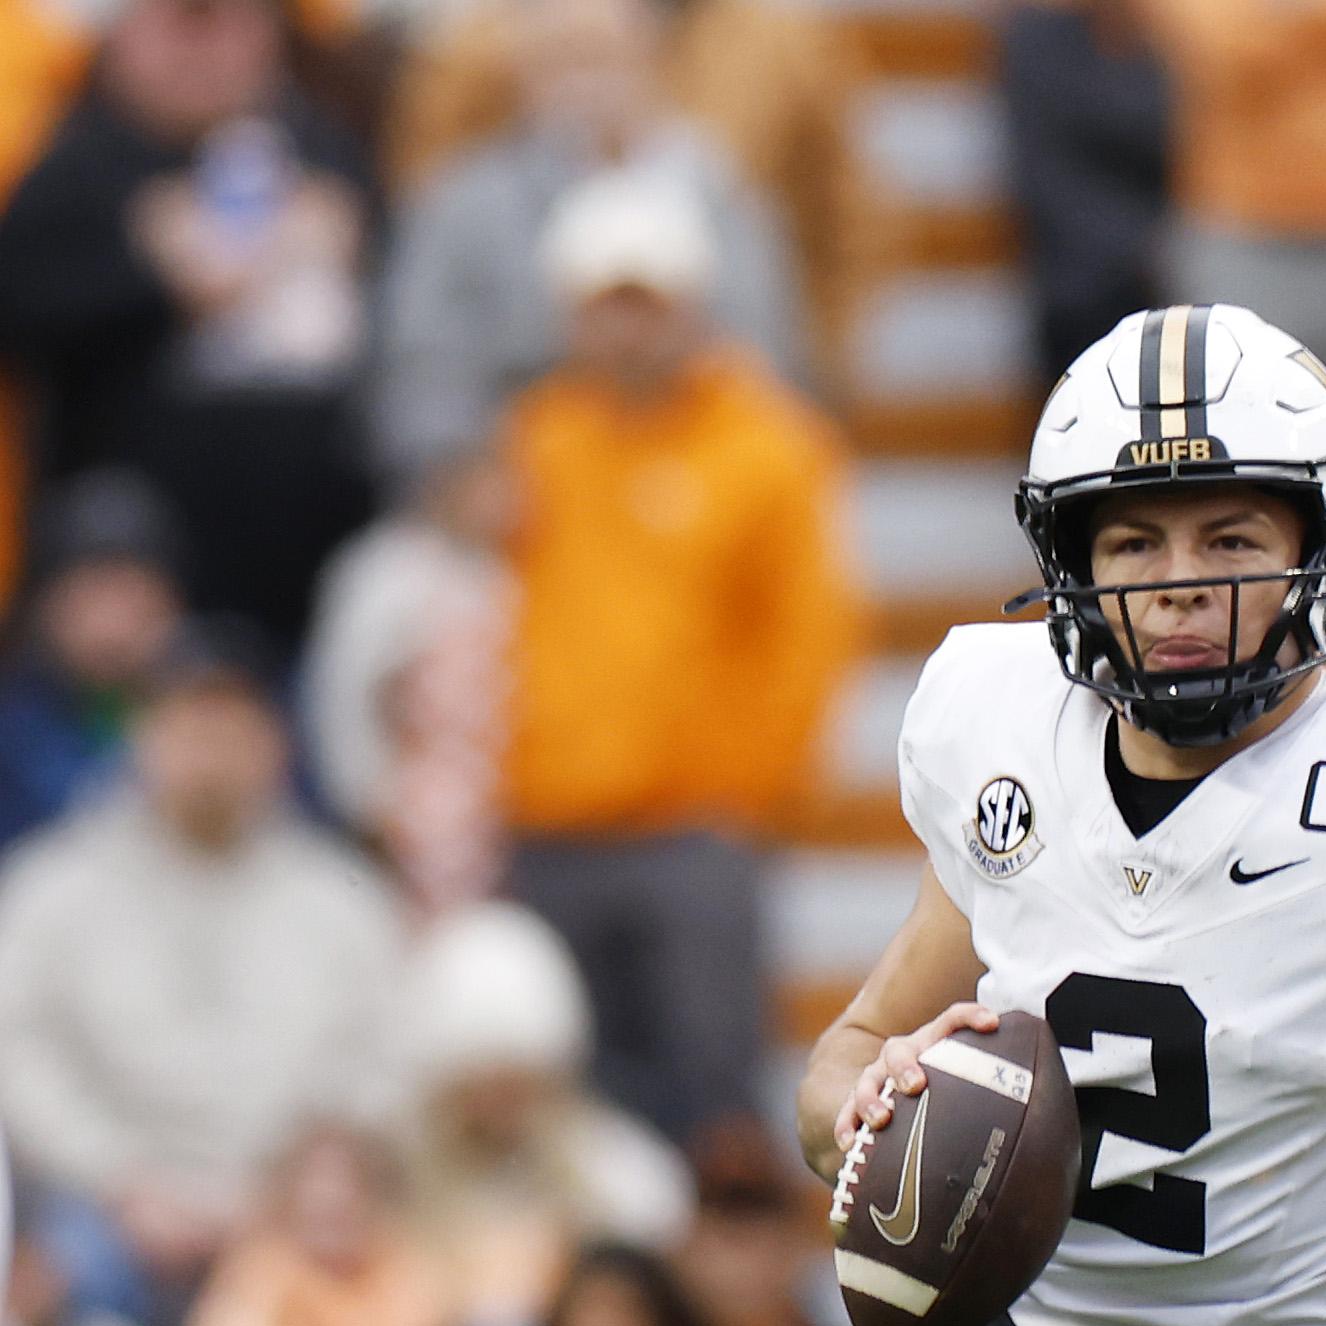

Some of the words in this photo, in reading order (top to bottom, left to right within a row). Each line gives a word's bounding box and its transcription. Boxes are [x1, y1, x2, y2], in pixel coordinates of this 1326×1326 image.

[1130, 439, 1211, 466] VUFB
[979, 779, 1031, 851] SEC
[1123, 867, 1152, 896] V
[1045, 971, 1211, 1257] 2
